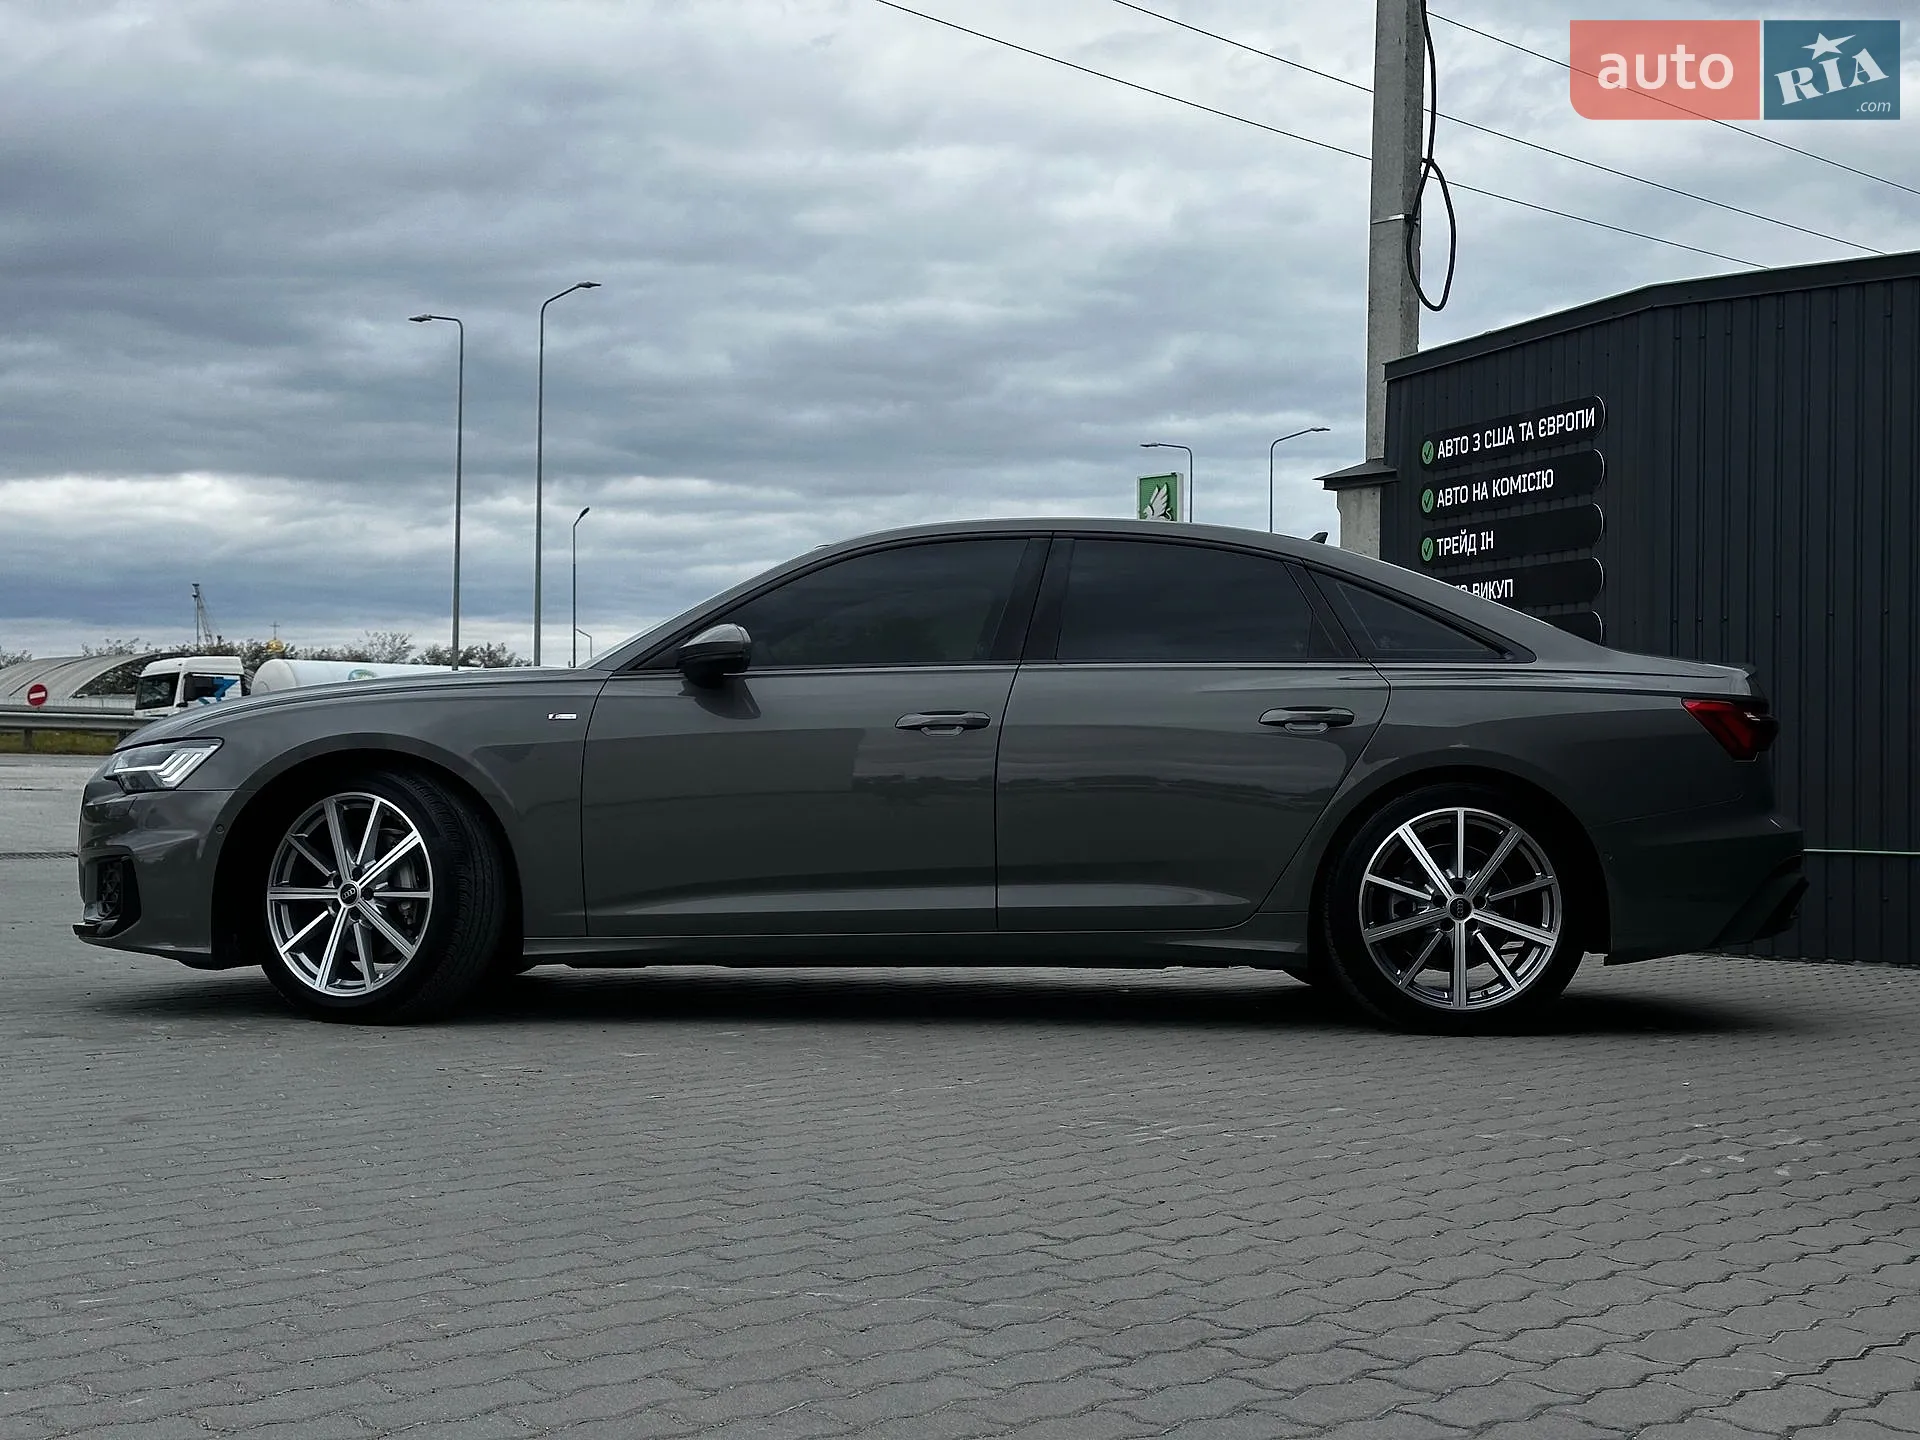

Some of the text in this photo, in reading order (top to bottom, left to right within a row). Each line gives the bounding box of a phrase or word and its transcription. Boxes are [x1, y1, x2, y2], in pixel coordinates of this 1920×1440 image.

[1437, 436, 1469, 459] АВТО
[1484, 425, 1515, 448] США
[1519, 420, 1534, 440] ТА
[1538, 407, 1595, 438] ЄВРОПИ
[1436, 469, 1554, 508] АВТО НА КОМІСІЮ
[1436, 529, 1494, 556] ТРЕЙД ІН
[1472, 579, 1514, 600] ВИКУП
